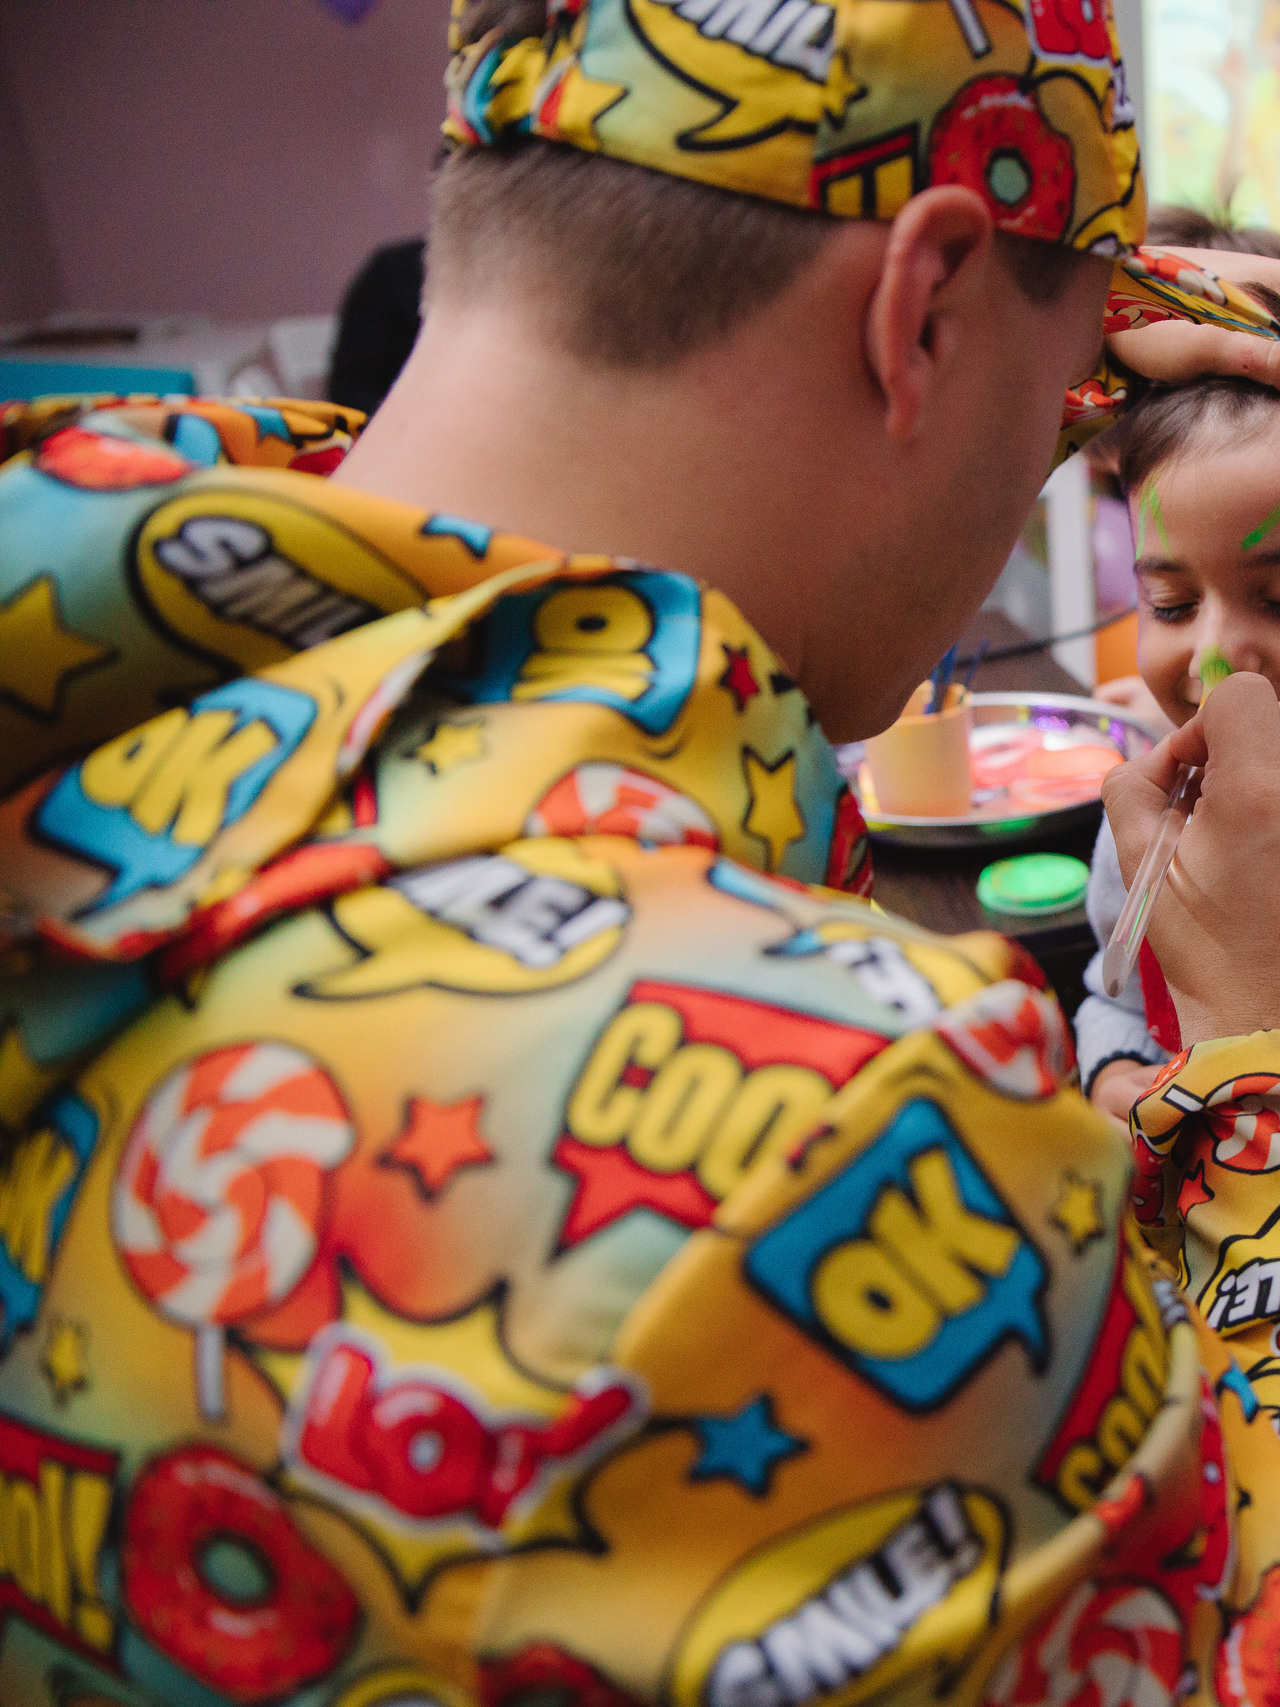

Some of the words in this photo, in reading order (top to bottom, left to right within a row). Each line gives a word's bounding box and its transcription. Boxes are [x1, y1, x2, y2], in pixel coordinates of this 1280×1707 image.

[80, 705, 280, 848] OK
[811, 1149, 1022, 1362] OK
[709, 1486, 980, 1707] SMILE!
